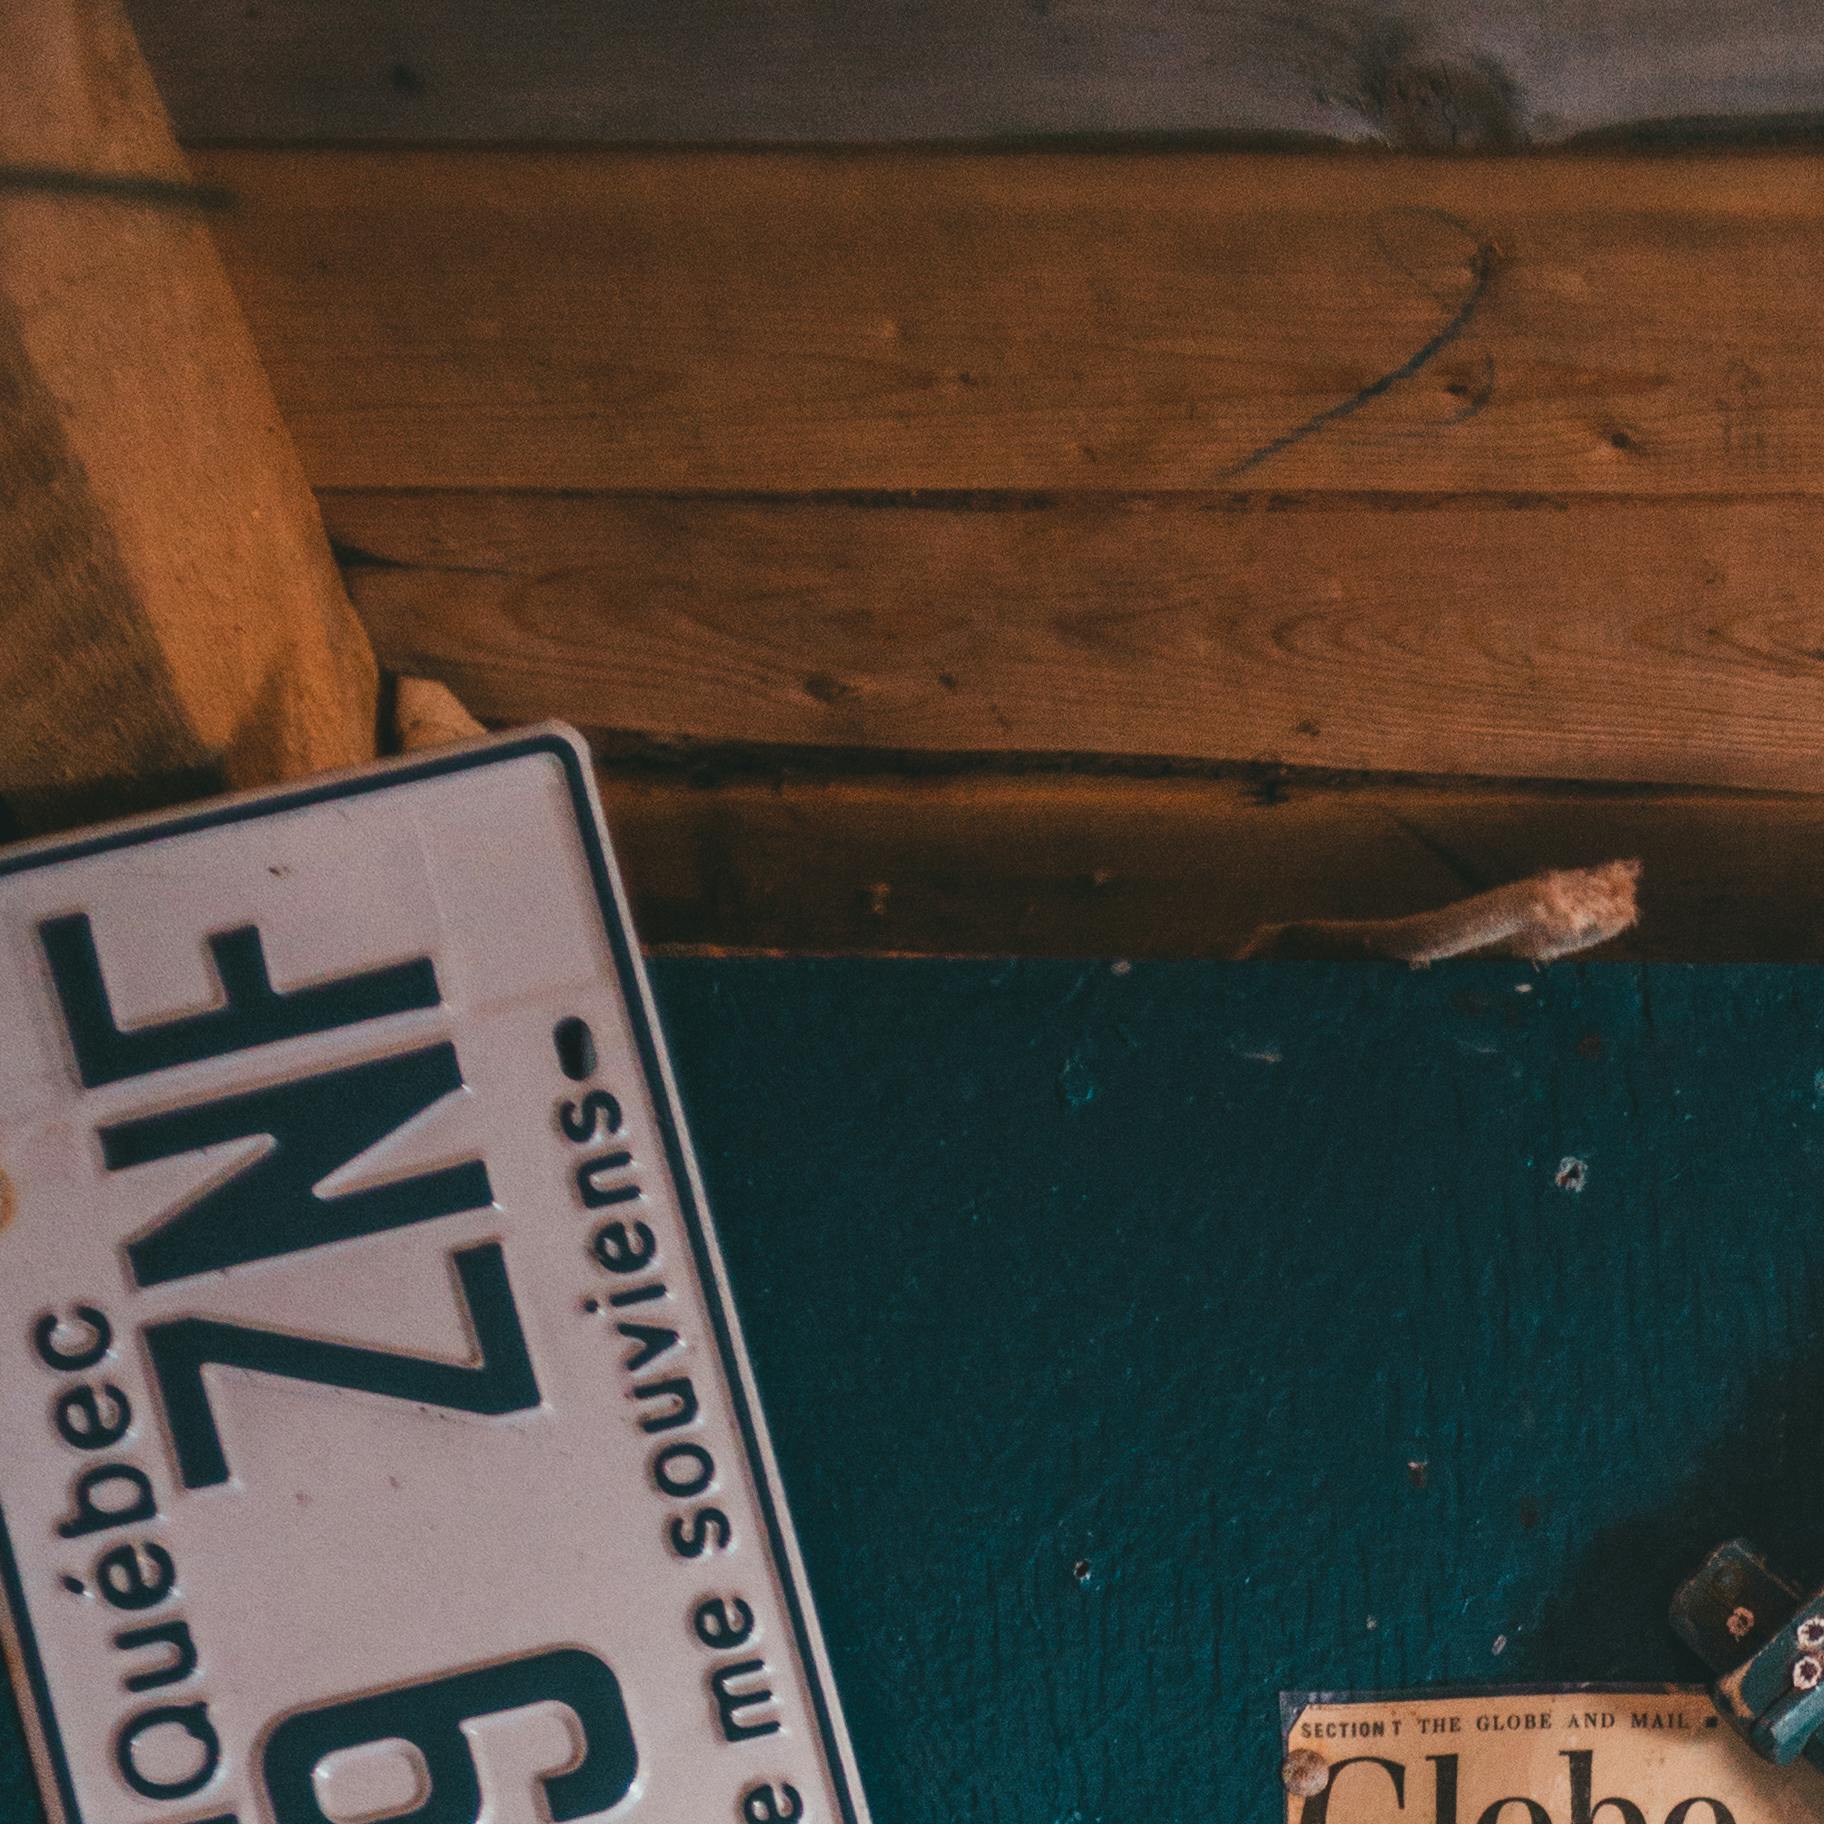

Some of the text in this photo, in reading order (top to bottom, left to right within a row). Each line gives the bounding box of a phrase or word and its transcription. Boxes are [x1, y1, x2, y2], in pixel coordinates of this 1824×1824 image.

[36, 908, 545, 1492] ZNF
[556, 1083, 737, 1562] souviens
[34, 1299, 224, 1806] Québec
[684, 1591, 785, 1746] me
[1301, 1713, 1688, 1738] SECTION T THE GLOBE AND MAIL
